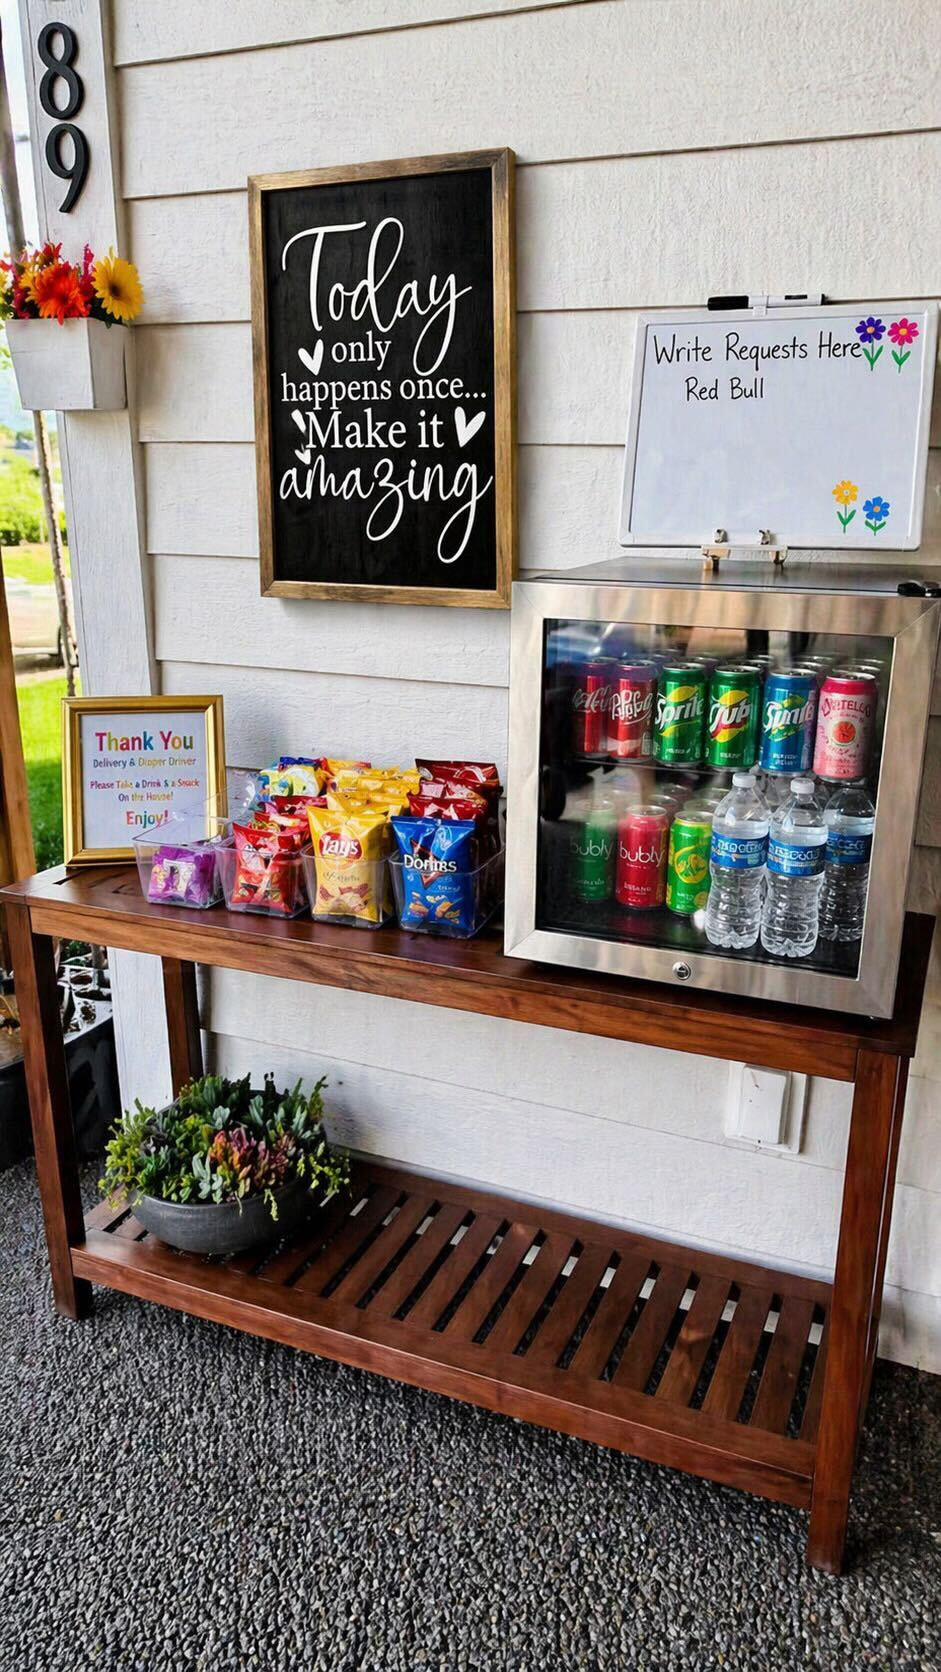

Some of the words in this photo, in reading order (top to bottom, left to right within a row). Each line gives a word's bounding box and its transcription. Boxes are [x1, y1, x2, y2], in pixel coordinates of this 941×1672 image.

[37, 22, 90, 214] 89
[282, 217, 473, 376] Today
[331, 330, 392, 371] only
[653, 333, 713, 365] Write
[725, 332, 808, 372] Requests
[818, 331, 863, 359] Here
[281, 372, 392, 410] happens
[400, 377, 487, 400] once...
[685, 376, 719, 402] Red
[730, 376, 764, 400] Bull
[305, 407, 407, 449] Make
[417, 409, 444, 449] it
[279, 454, 493, 564] amazing
[655, 693, 704, 731] Sprite
[95, 731, 154, 752] Thank
[160, 730, 194, 750] You
[93, 758, 127, 769] Delivery
[129, 758, 136, 767] &
[90, 780, 115, 789] Please
[141, 779, 162, 788] Drink
[118, 793, 130, 802] On
[126, 809, 169, 829] Enjoy!
[619, 841, 665, 868] bubly
